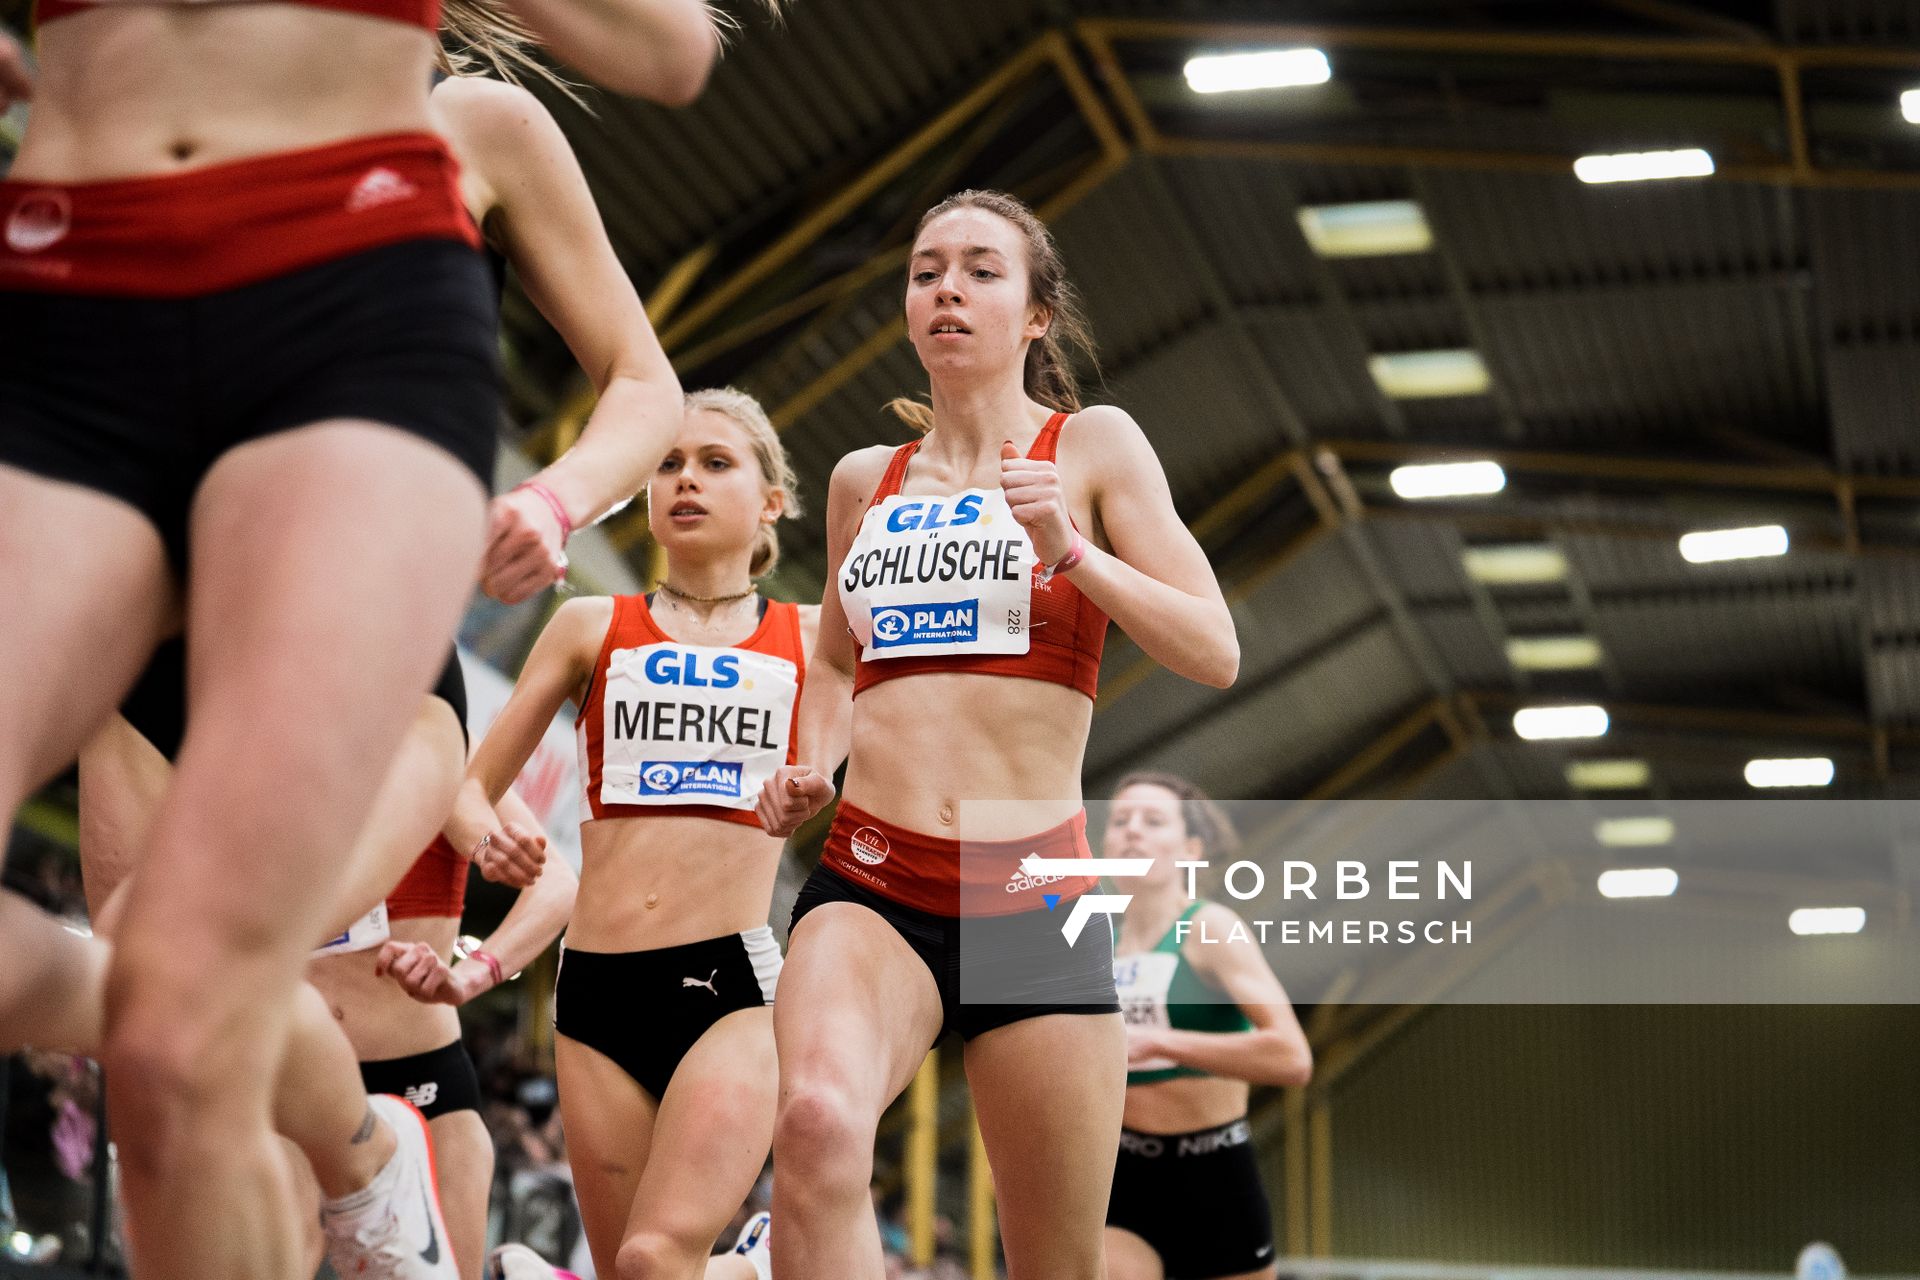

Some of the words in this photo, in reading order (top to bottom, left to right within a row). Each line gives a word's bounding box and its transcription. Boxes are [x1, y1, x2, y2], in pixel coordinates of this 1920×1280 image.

[845, 532, 1023, 593] SCHLÜSCHE
[914, 608, 973, 629] PLAN
[1007, 609, 1021, 635] 228
[913, 629, 973, 639] INTERNATIONAL
[614, 700, 778, 750] MERKEL
[682, 765, 738, 786] PLAN
